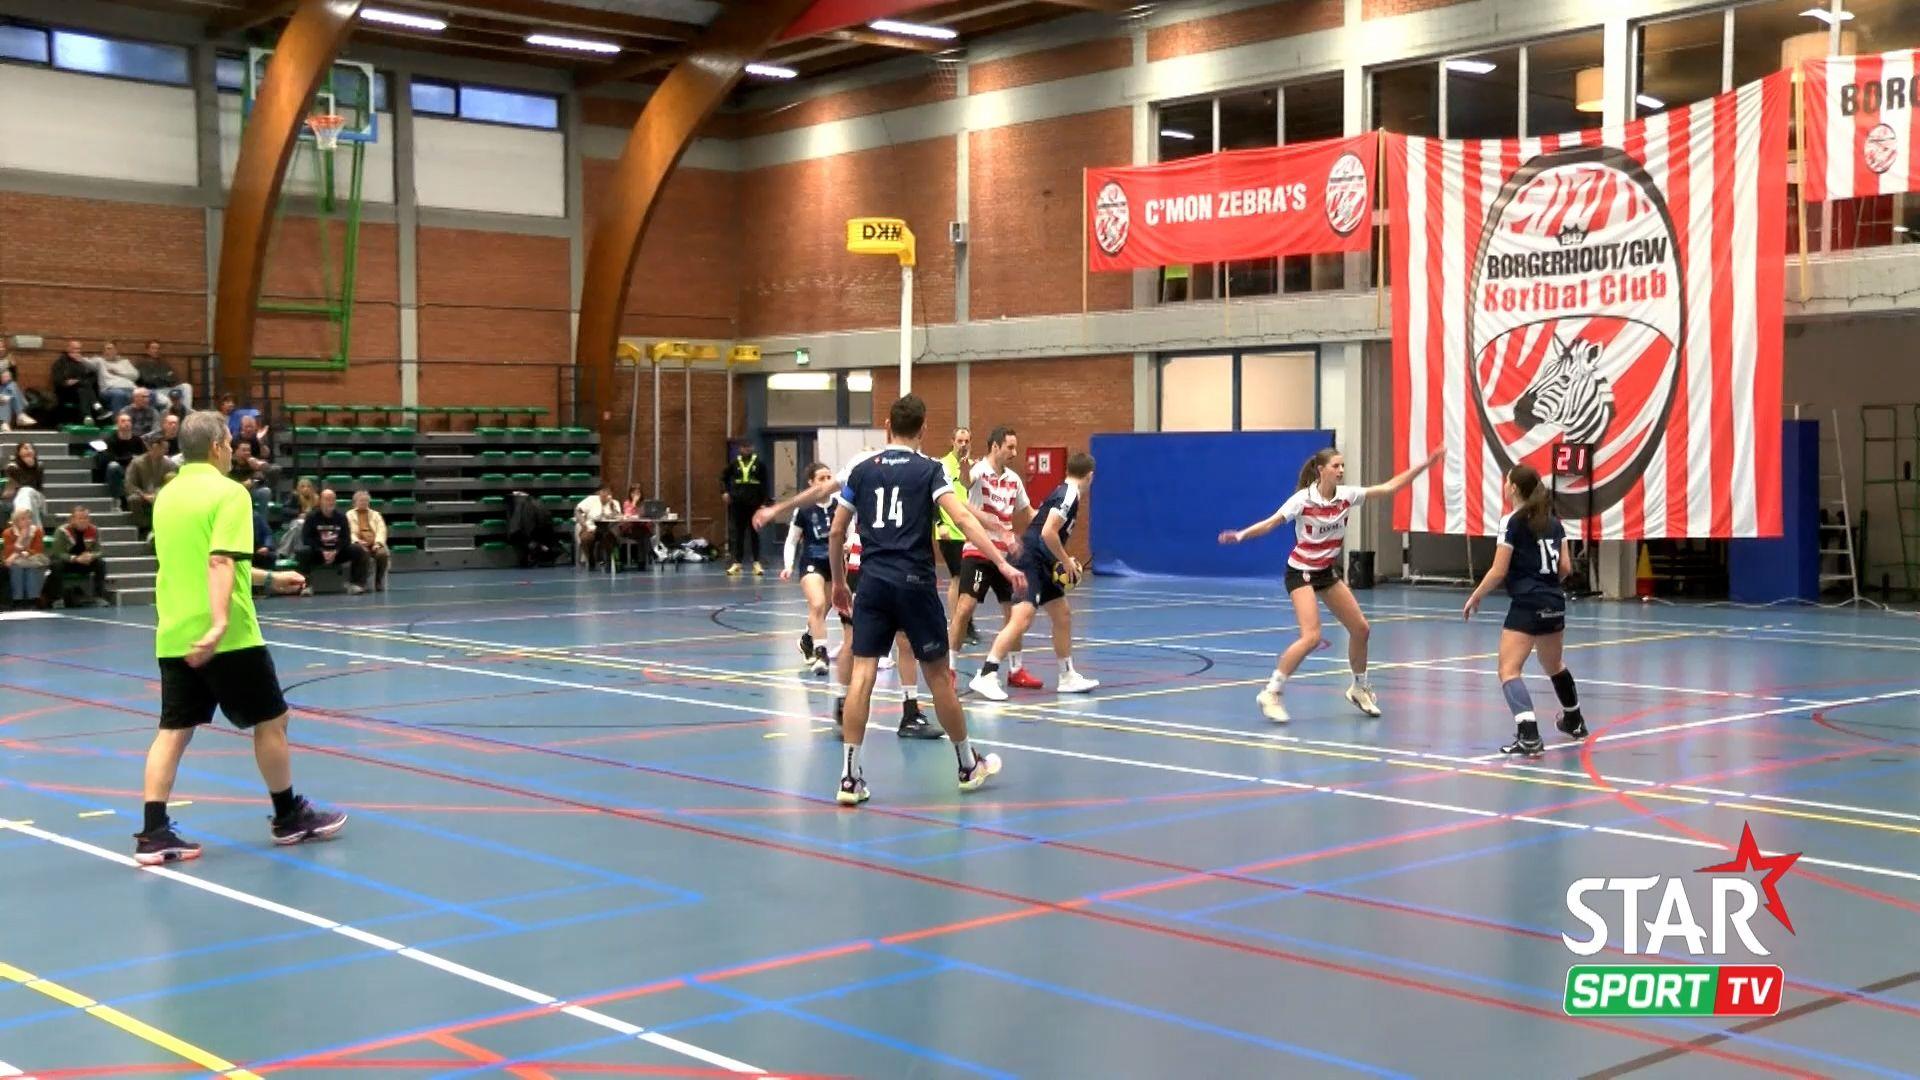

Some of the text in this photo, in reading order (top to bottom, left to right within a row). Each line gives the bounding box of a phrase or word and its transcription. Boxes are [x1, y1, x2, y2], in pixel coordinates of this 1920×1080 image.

[1145, 183, 1307, 226] C'MON ZEBRA'S
[1487, 237, 1668, 280] BORGERHOUT/GW
[1484, 269, 1667, 312] Korfbal Club
[1556, 447, 1585, 471] 21
[872, 486, 903, 529] 14
[1537, 538, 1560, 575] 15
